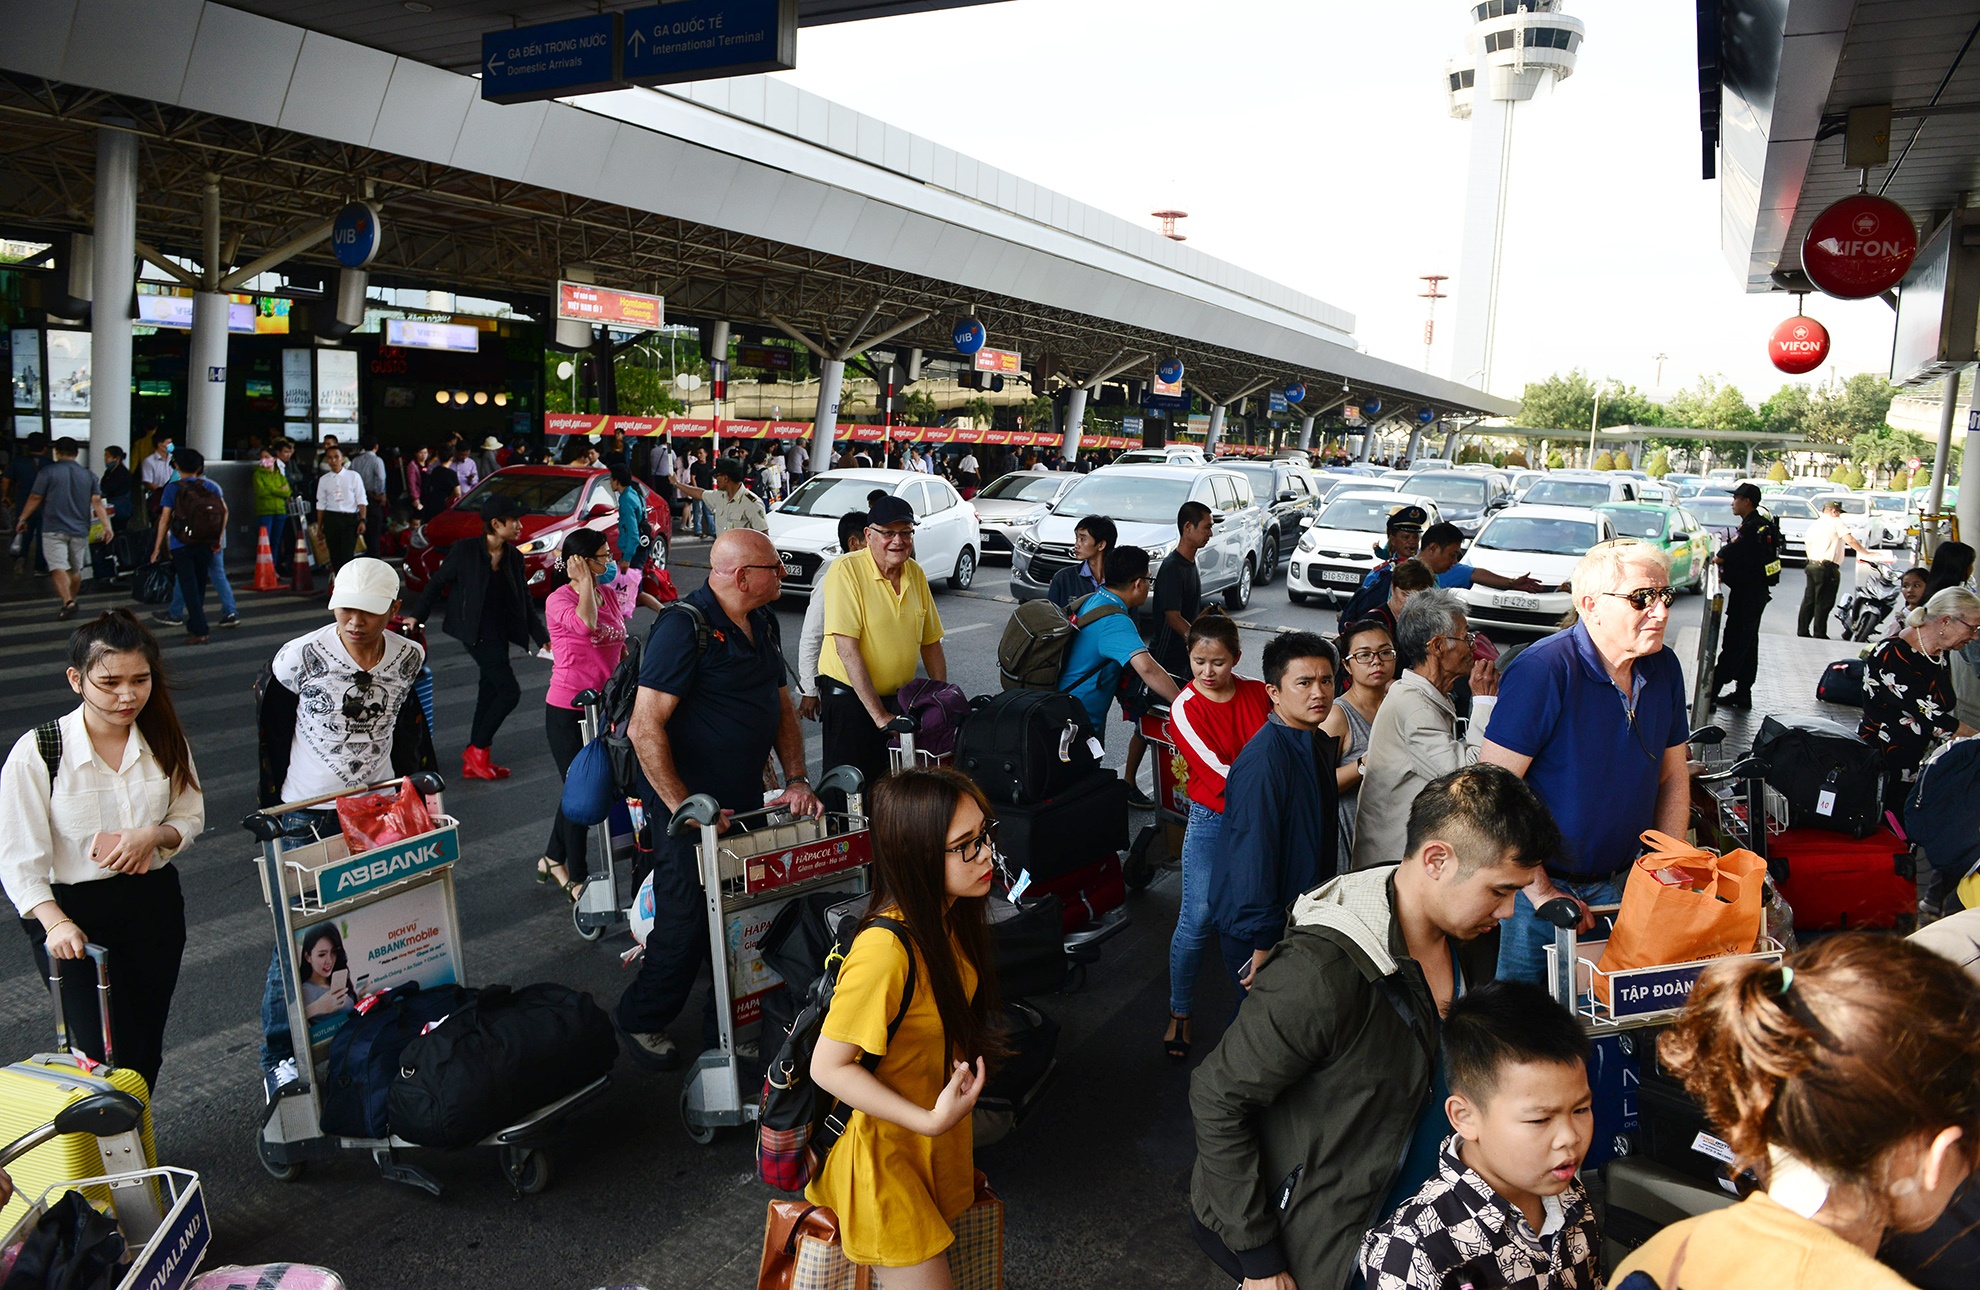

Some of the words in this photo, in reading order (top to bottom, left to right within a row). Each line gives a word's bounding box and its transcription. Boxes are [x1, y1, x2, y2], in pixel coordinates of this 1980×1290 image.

[654, 25, 669, 38] GA
[672, 17, 705, 33] QUỐC
[707, 12, 723, 29] TẾ
[507, 47, 521, 60] GA
[522, 43, 542, 58] ĐẾN
[545, 38, 577, 55] TRONG
[579, 33, 607, 48] NƯỚC
[653, 38, 715, 55] International
[718, 29, 764, 47] Terminal
[507, 61, 547, 76] Domestic
[548, 56, 582, 72] Arrivals
[335, 229, 356, 244] VIB
[955, 332, 974, 344] VIB
[1780, 341, 1820, 351] VIFON
[1160, 366, 1174, 375] VIB
[337, 842, 441, 892] ABBANK
[795, 848, 831, 864] HAPACOL
[388, 926, 405, 941] DỊCH
[406, 923, 417, 933] VỤ
[368, 927, 439, 961] ABBANKmobile
[1620, 984, 1650, 1003] TẬP
[1652, 979, 1695, 998] ĐOÀN
[147, 1213, 201, 1290] OVALAND
